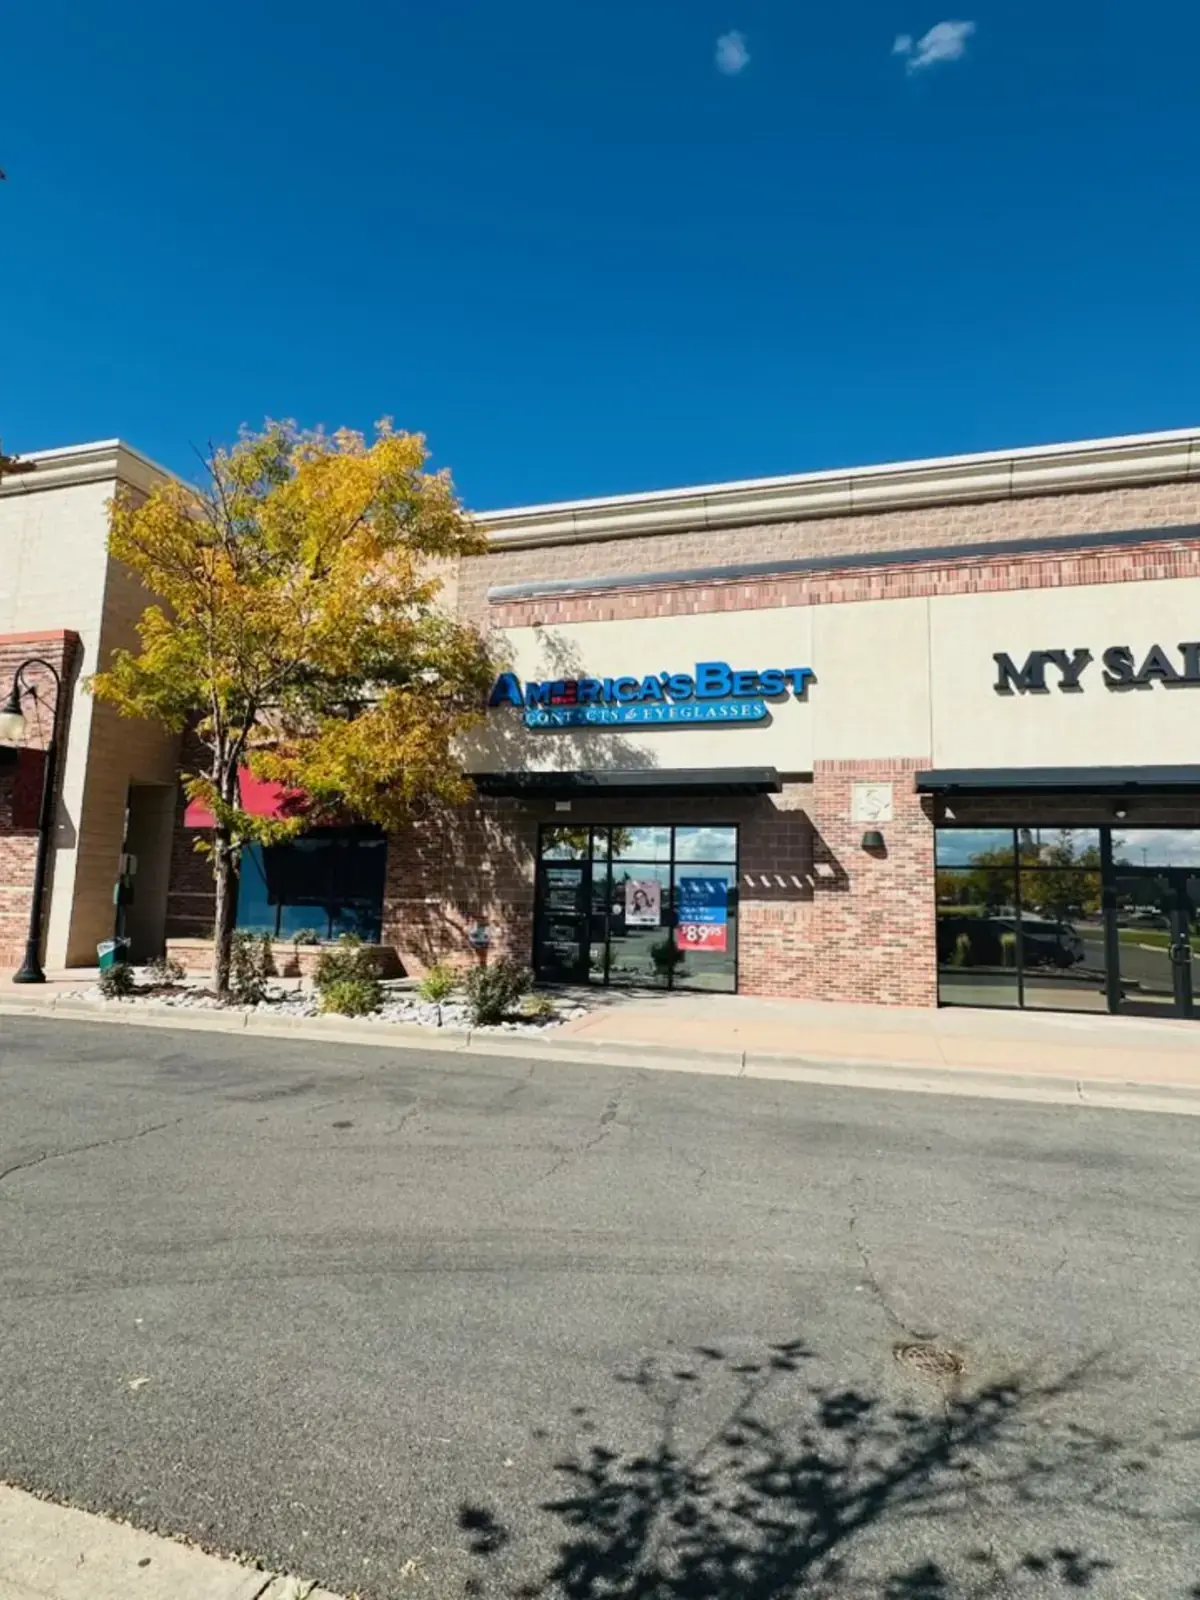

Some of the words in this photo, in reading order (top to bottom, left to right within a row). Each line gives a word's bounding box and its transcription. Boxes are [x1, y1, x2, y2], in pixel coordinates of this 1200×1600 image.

[488, 671, 694, 706] AMERICA'S
[695, 661, 814, 698] BEST
[993, 648, 1092, 692] MY
[526, 708, 619, 725] CONTCTS
[624, 707, 638, 720] &
[643, 704, 763, 720] EYEGLASSES
